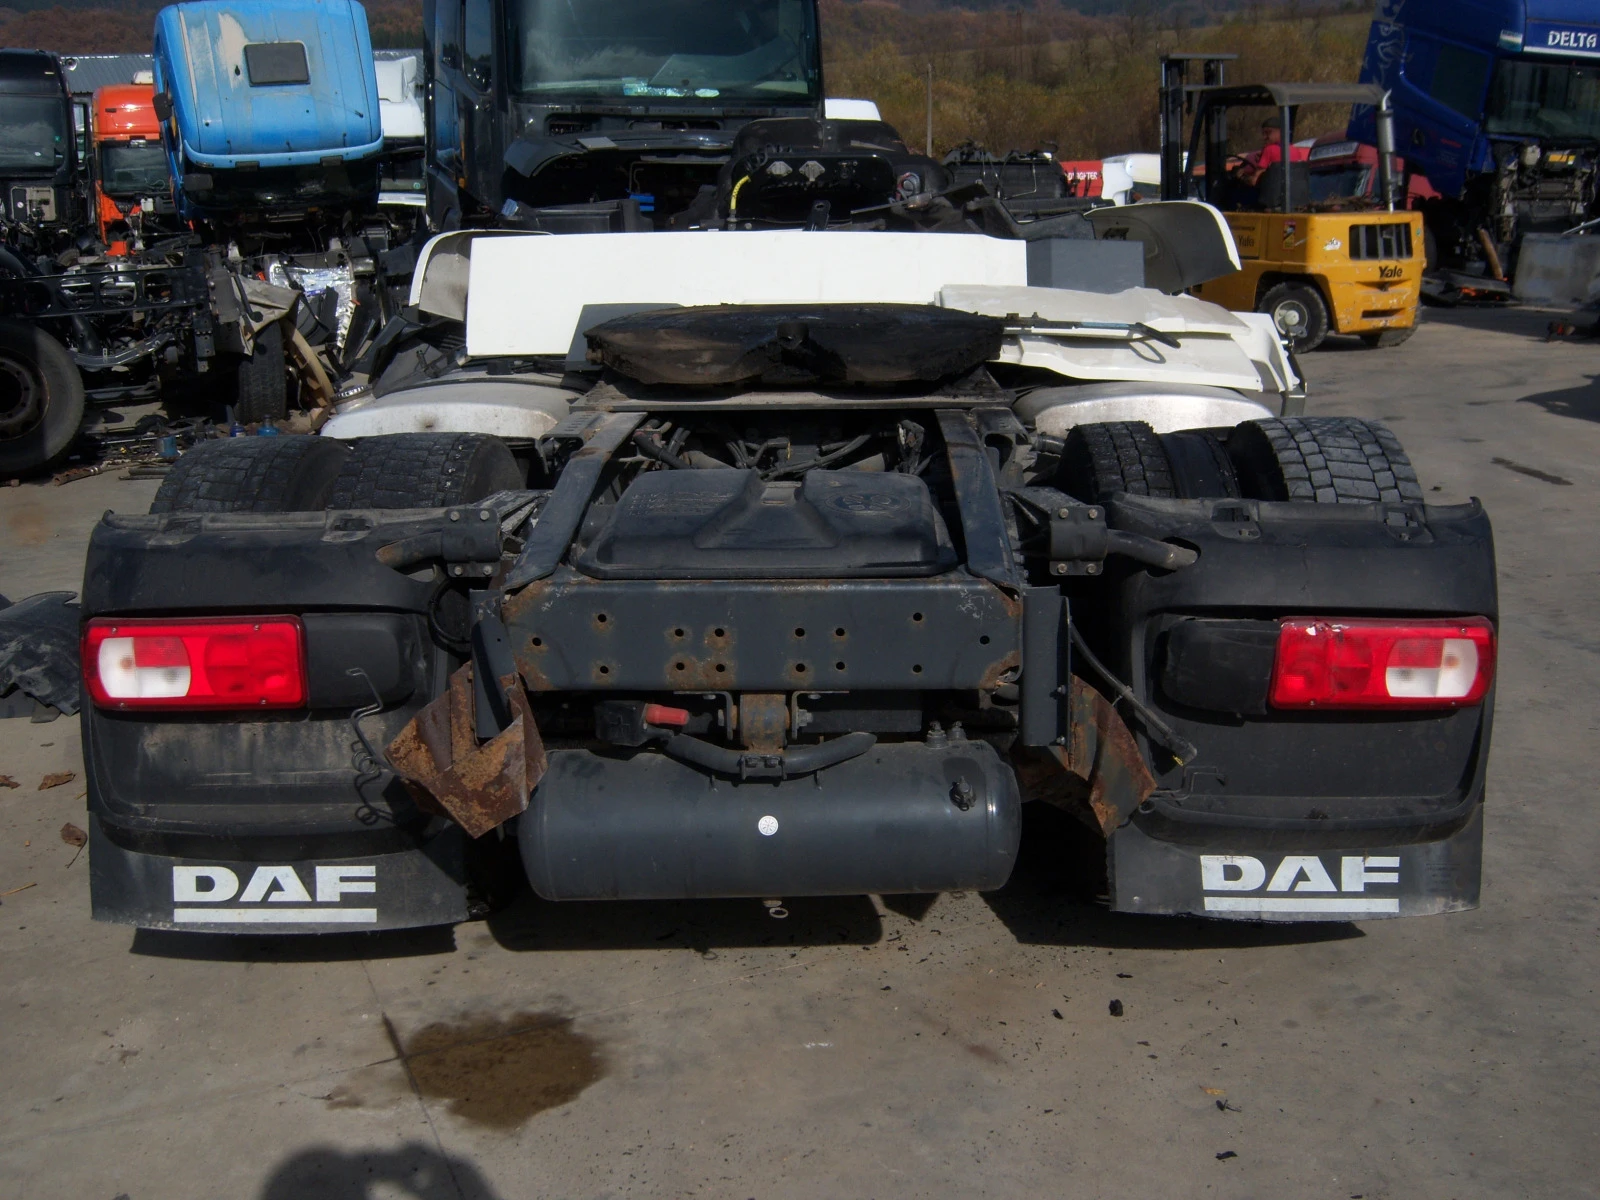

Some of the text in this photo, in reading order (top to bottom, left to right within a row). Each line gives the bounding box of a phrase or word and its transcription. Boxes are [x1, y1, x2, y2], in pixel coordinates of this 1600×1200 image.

[1547, 30, 1598, 48] DELTA
[1378, 265, 1403, 278] Yale
[172, 865, 377, 902] DAF
[1200, 855, 1400, 892] DAF
